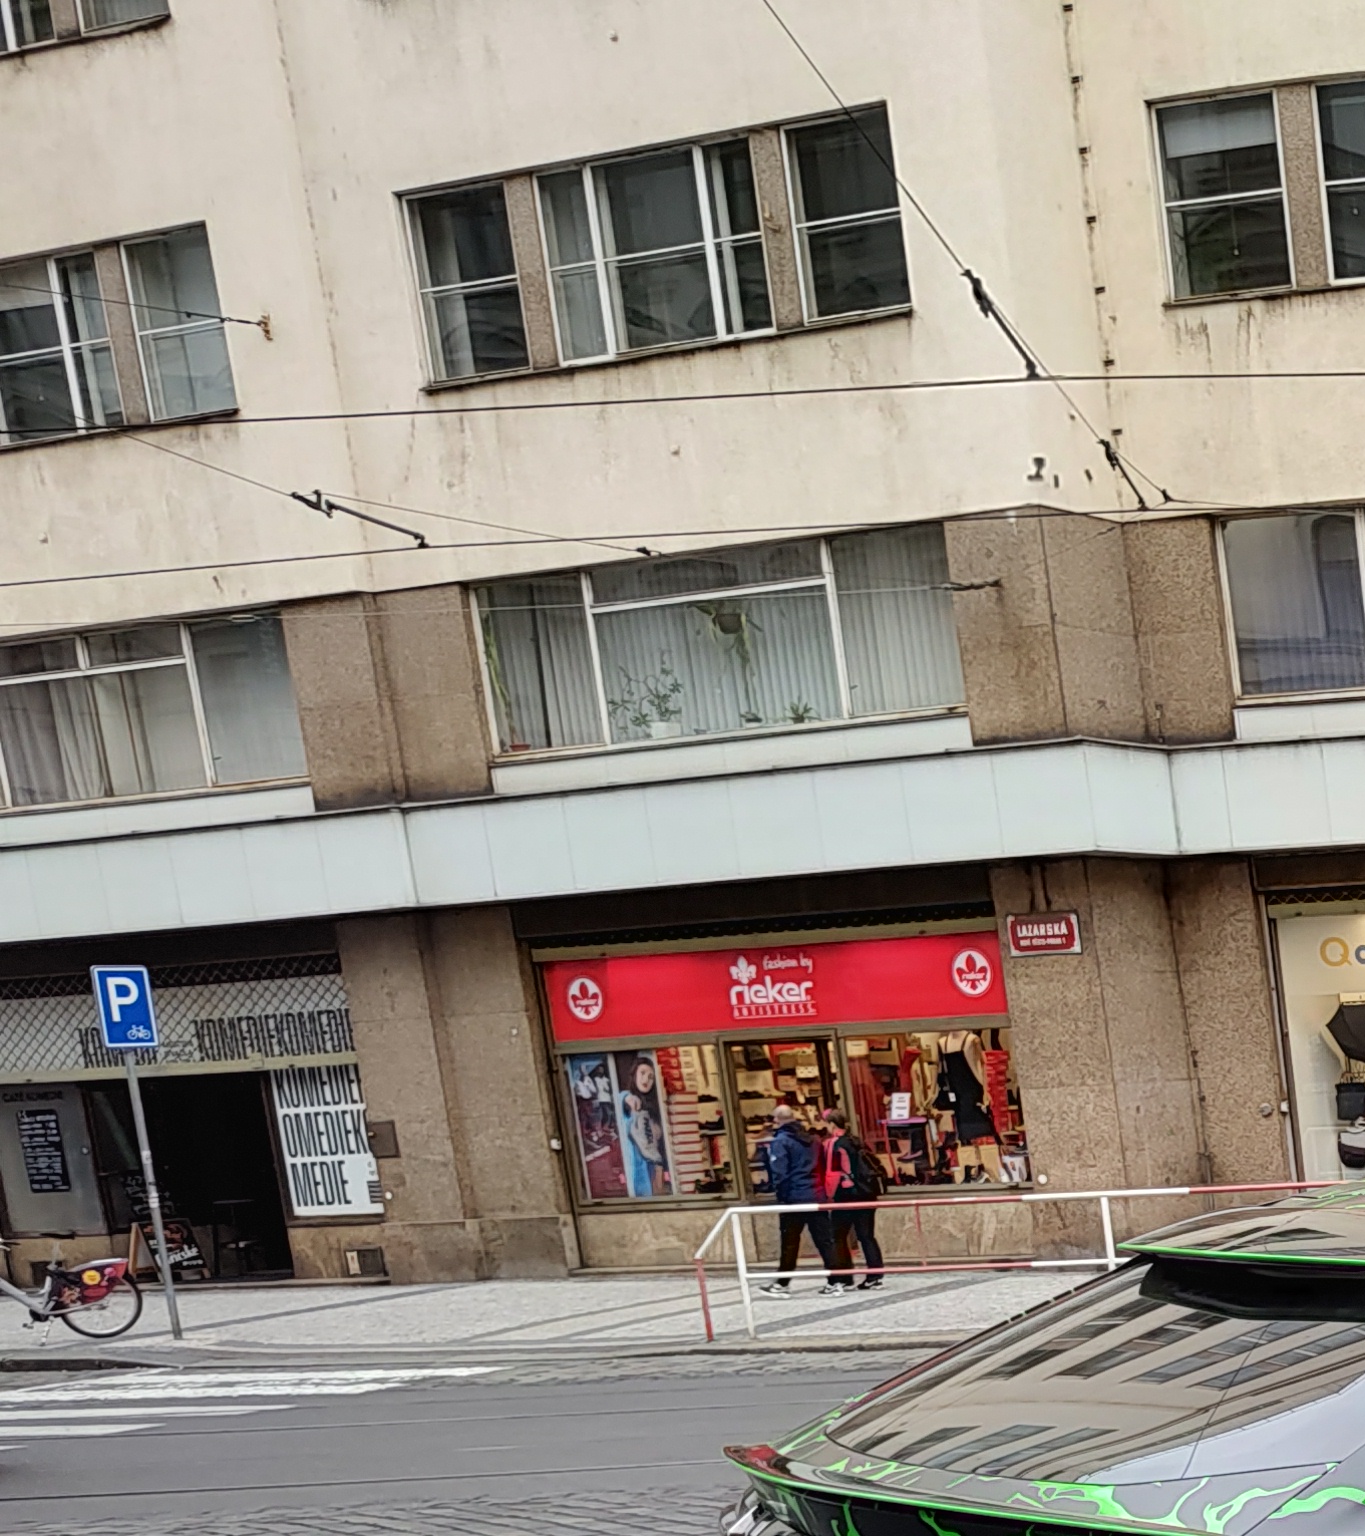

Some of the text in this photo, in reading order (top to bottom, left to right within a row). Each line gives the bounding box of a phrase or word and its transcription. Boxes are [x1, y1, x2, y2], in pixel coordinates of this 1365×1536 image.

[1016, 920, 1068, 938] LAZARSKÁ
[106, 976, 140, 1023] P
[730, 975, 814, 1006] rieker
[282, 1109, 371, 1158] OMEDIEK
[290, 1160, 352, 1208] MEDIE
